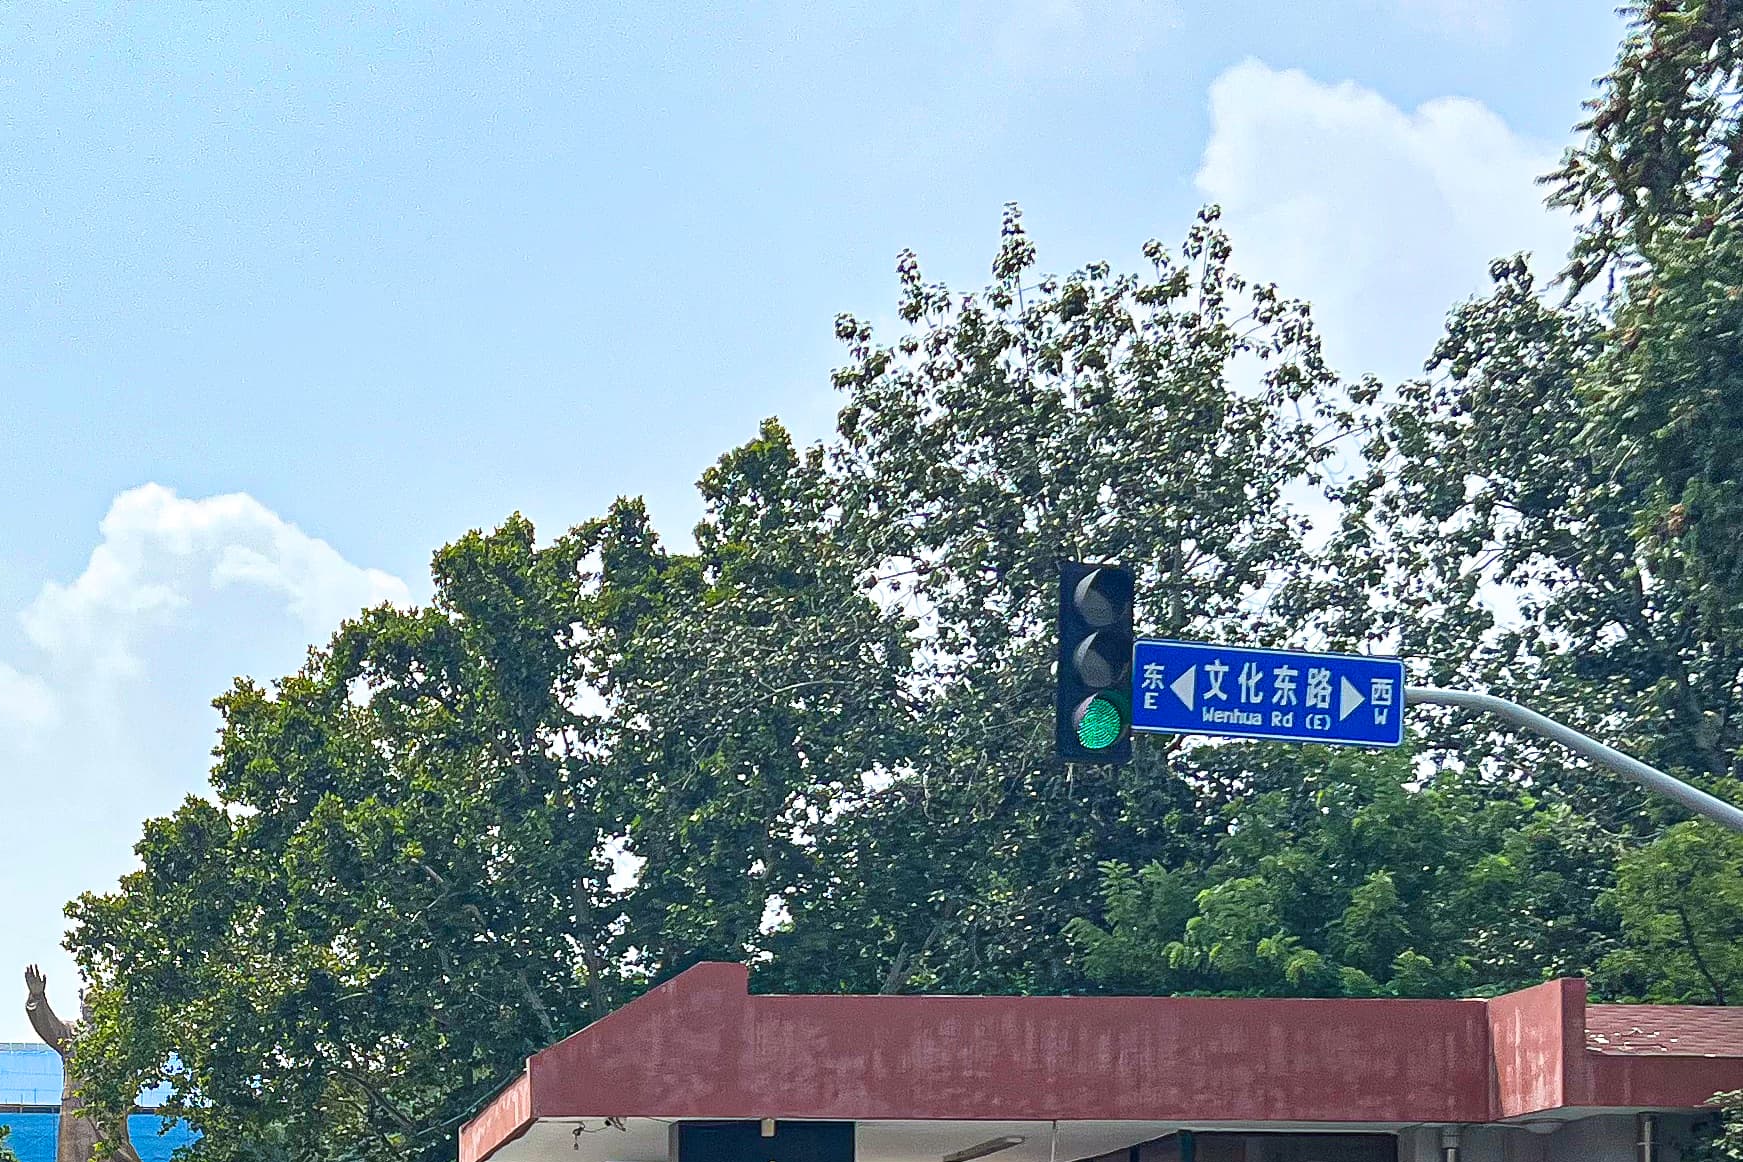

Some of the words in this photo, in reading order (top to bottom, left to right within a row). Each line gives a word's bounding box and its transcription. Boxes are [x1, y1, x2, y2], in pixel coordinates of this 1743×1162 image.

[1142, 662, 1165, 690] 东
[1203, 658, 1333, 709] 文化东路
[1143, 692, 1159, 710] E
[1370, 678, 1394, 706] 西
[1202, 706, 1262, 726] Wenhua
[1271, 711, 1294, 728] Rd
[1305, 713, 1331, 731] (E)
[1374, 707, 1388, 725] W
